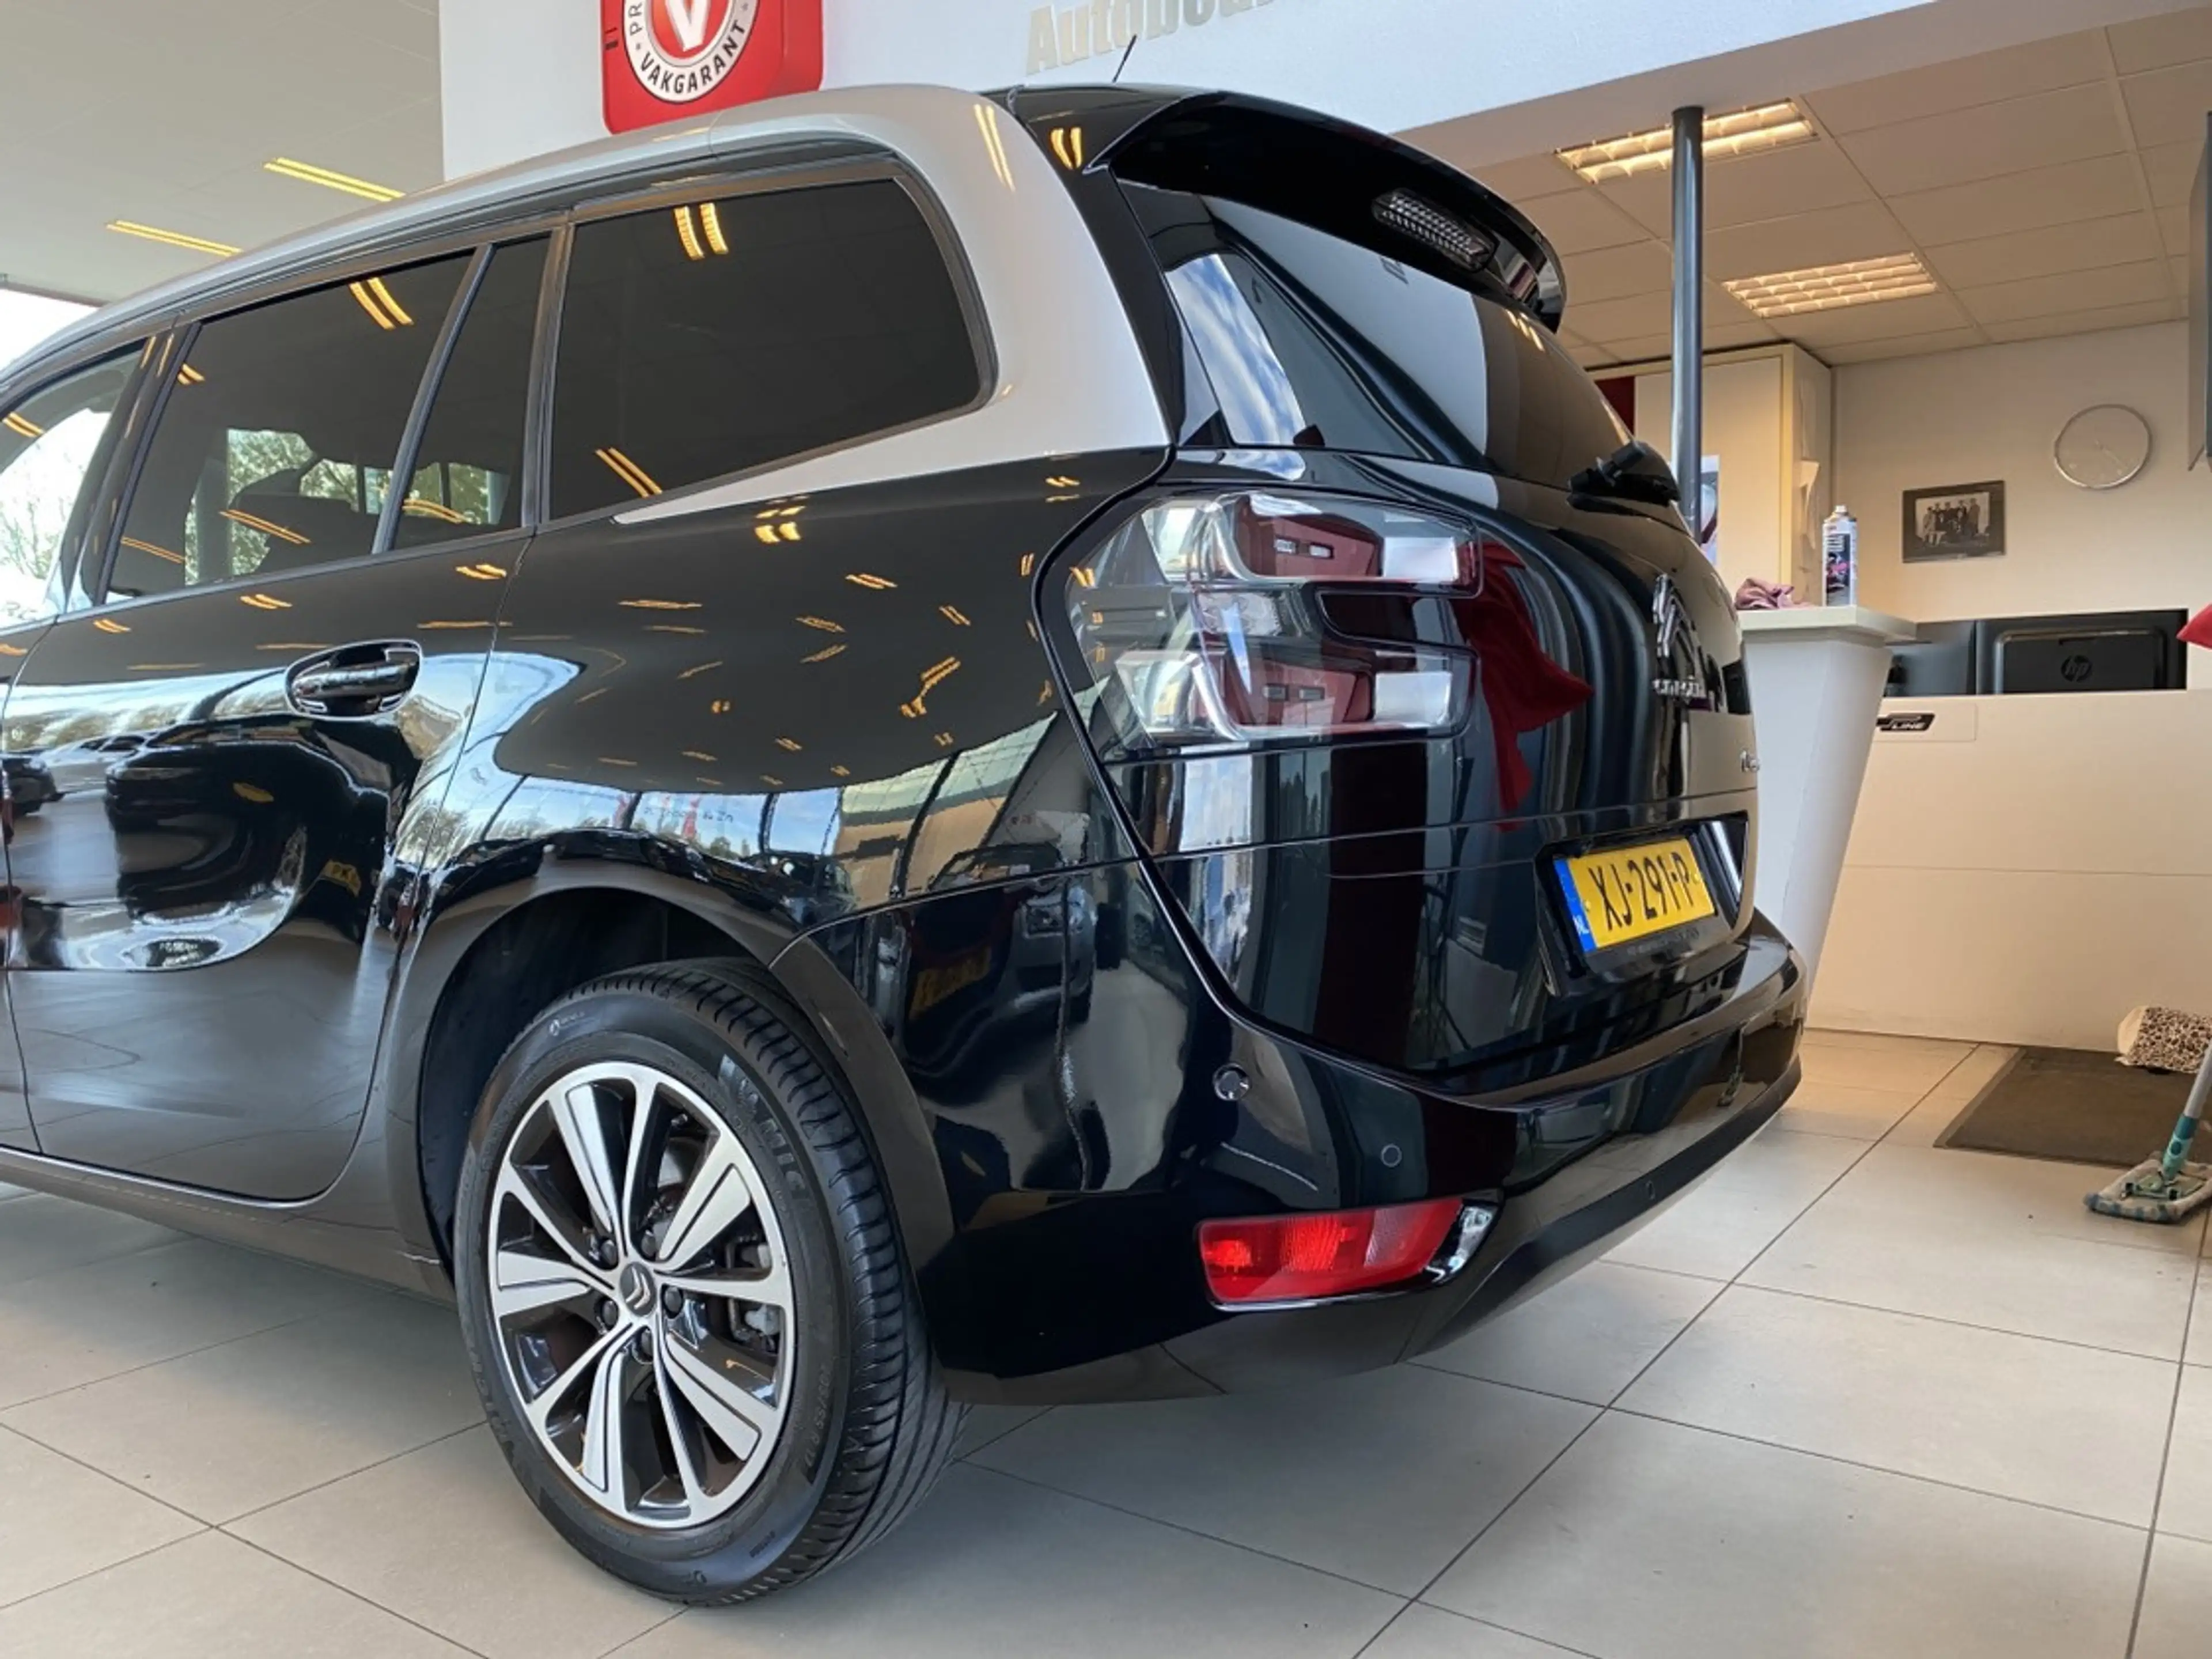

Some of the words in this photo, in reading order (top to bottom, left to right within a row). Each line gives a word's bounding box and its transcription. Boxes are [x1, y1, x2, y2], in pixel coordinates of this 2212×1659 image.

[640, 20, 745, 94] VAKGARANT
[2062, 655, 2091, 683] hp
[1588, 851, 1694, 931] XJ-291-P
